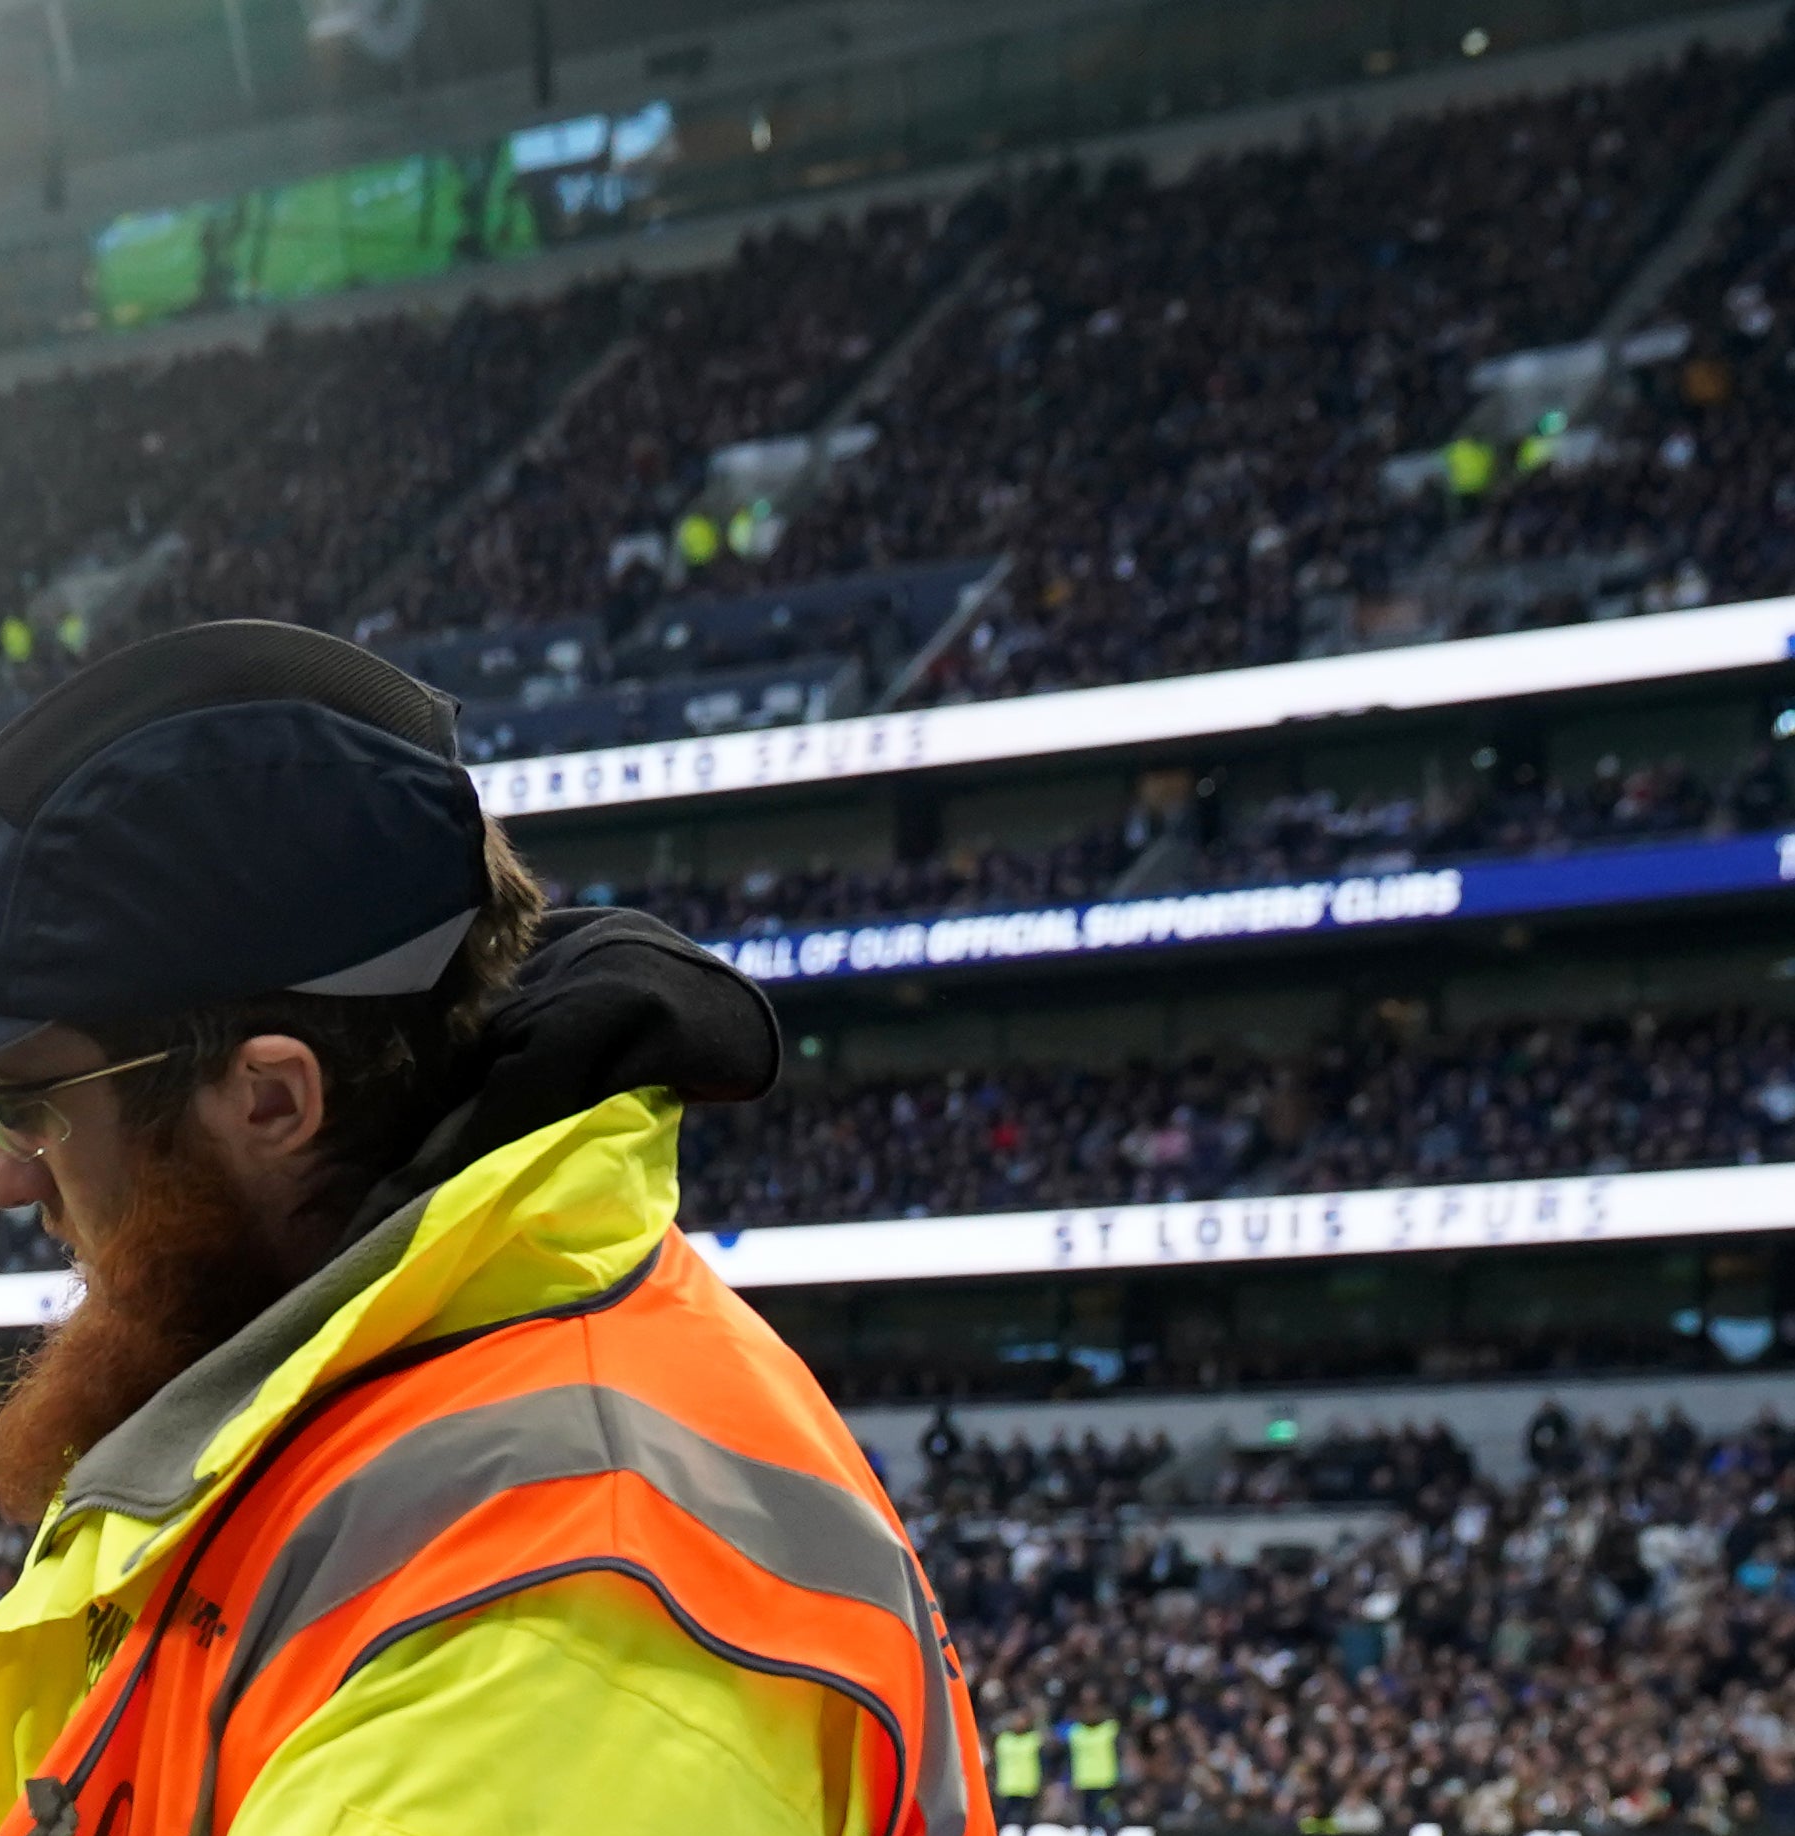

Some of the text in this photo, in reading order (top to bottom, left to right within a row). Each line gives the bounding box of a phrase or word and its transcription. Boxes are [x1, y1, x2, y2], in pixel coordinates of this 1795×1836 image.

[1052, 1180, 1616, 1262] ST LOUIS SPURS
